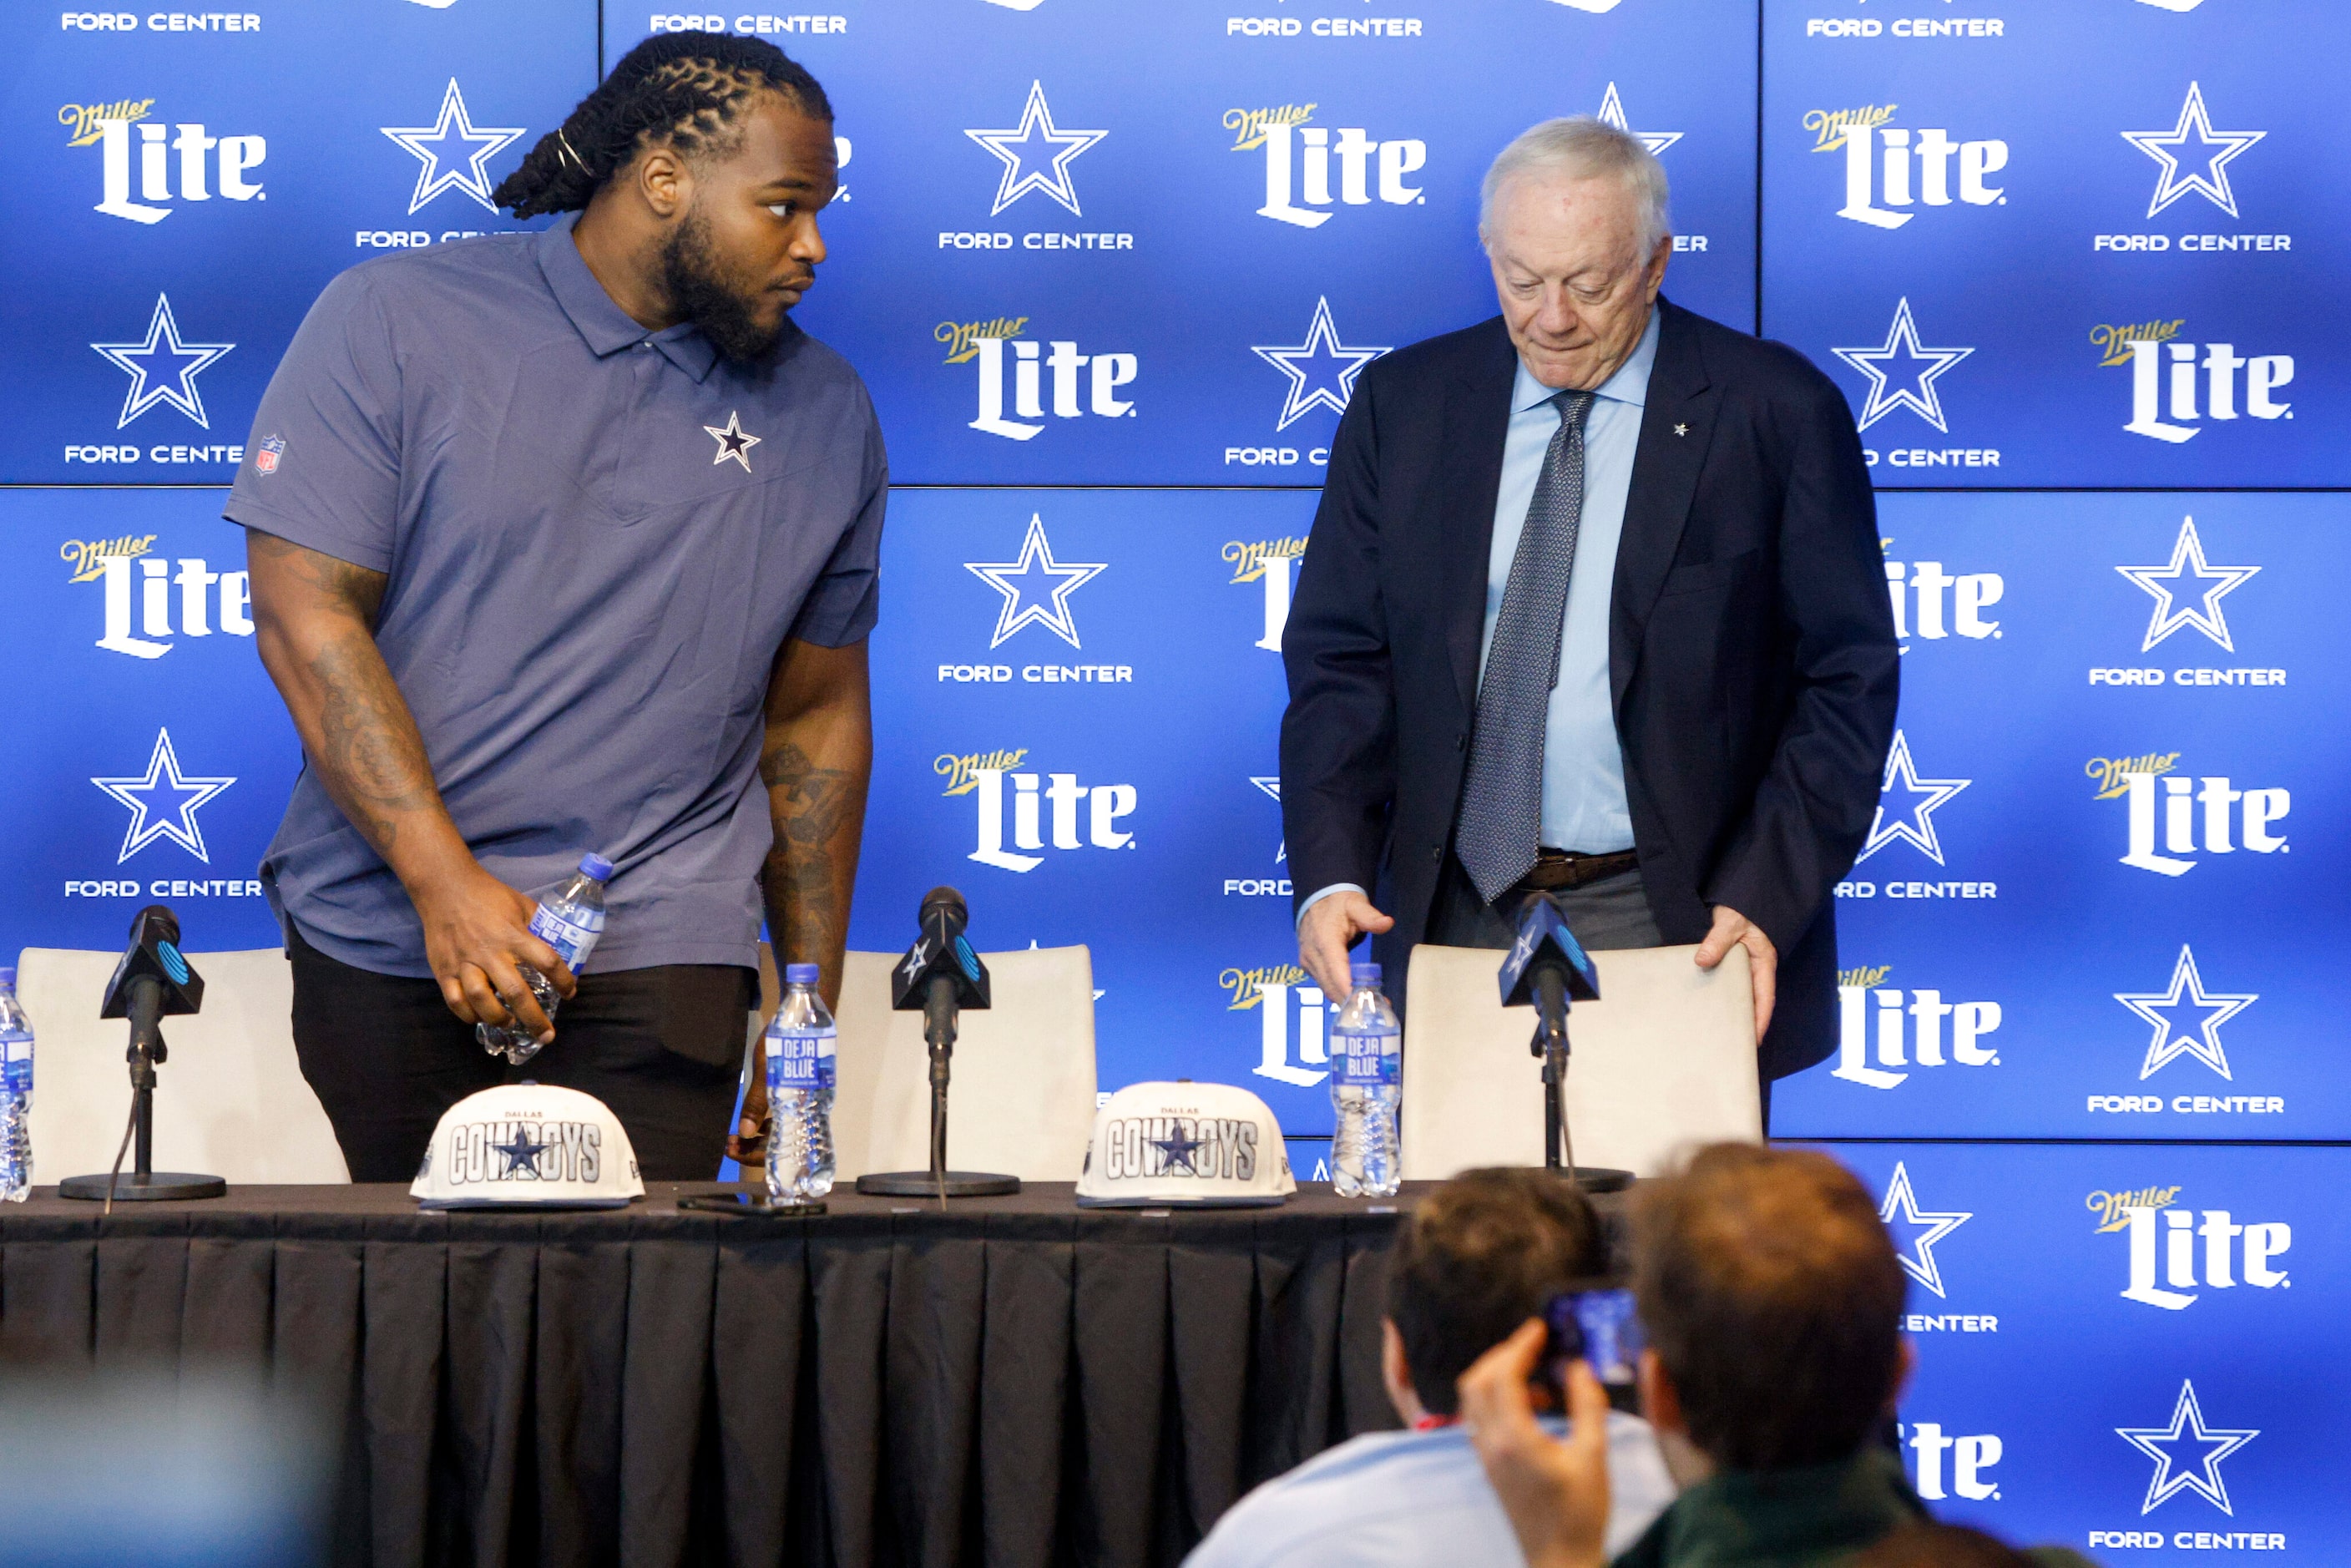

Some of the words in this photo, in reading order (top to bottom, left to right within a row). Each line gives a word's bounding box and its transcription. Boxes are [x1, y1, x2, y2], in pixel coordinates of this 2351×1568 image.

[62, 13, 138, 31] FORD
[148, 13, 260, 32] CENTER
[650, 14, 726, 33] FORD
[735, 15, 847, 33] CENTER
[1226, 18, 1302, 36] FORD
[1311, 18, 1422, 36] CENTER
[1807, 18, 1883, 37] FORD
[1891, 18, 2005, 37] CENTER
[58, 99, 155, 147] Miller
[1223, 103, 1317, 151] Miller
[1802, 104, 1898, 152] Miller
[356, 230, 431, 248] FORD
[938, 233, 1013, 249] FORD
[1023, 233, 1133, 250] CENTER
[2095, 235, 2169, 251] FORD
[2180, 235, 2291, 251] CENTER
[934, 316, 1029, 364] Miller
[2090, 319, 2186, 367] Miller
[65, 446, 139, 463] FORD
[150, 446, 244, 463] CENTE
[257, 449, 277, 471] NFL
[1225, 448, 1299, 465] FORD
[1888, 449, 2000, 467] CENTER
[60, 534, 157, 583] Miller
[938, 665, 1013, 682] FORD
[1023, 665, 1133, 682] CENTER
[2089, 669, 2166, 685] FORD
[2174, 669, 2287, 685] CENTER
[933, 748, 1028, 797] Miller
[2085, 752, 2181, 799] Miller
[64, 881, 140, 897] FORD
[150, 881, 262, 897] CENTER
[1833, 882, 1877, 898] RD
[1886, 882, 1997, 898] CENTER
[1838, 965, 1892, 989] iller
[1252, 984, 1341, 1087] Li
[784, 1039, 816, 1059] DEJA
[1347, 1036, 1379, 1056] DEJA
[783, 1059, 815, 1079] BLUE
[1347, 1056, 1379, 1076] BLUE
[2087, 1095, 2164, 1113] FORD
[2172, 1096, 2285, 1113] CENTER
[2086, 1186, 2182, 1234] Miller
[2089, 1531, 2164, 1549] FORD
[2174, 1532, 2286, 1550] CENTER
